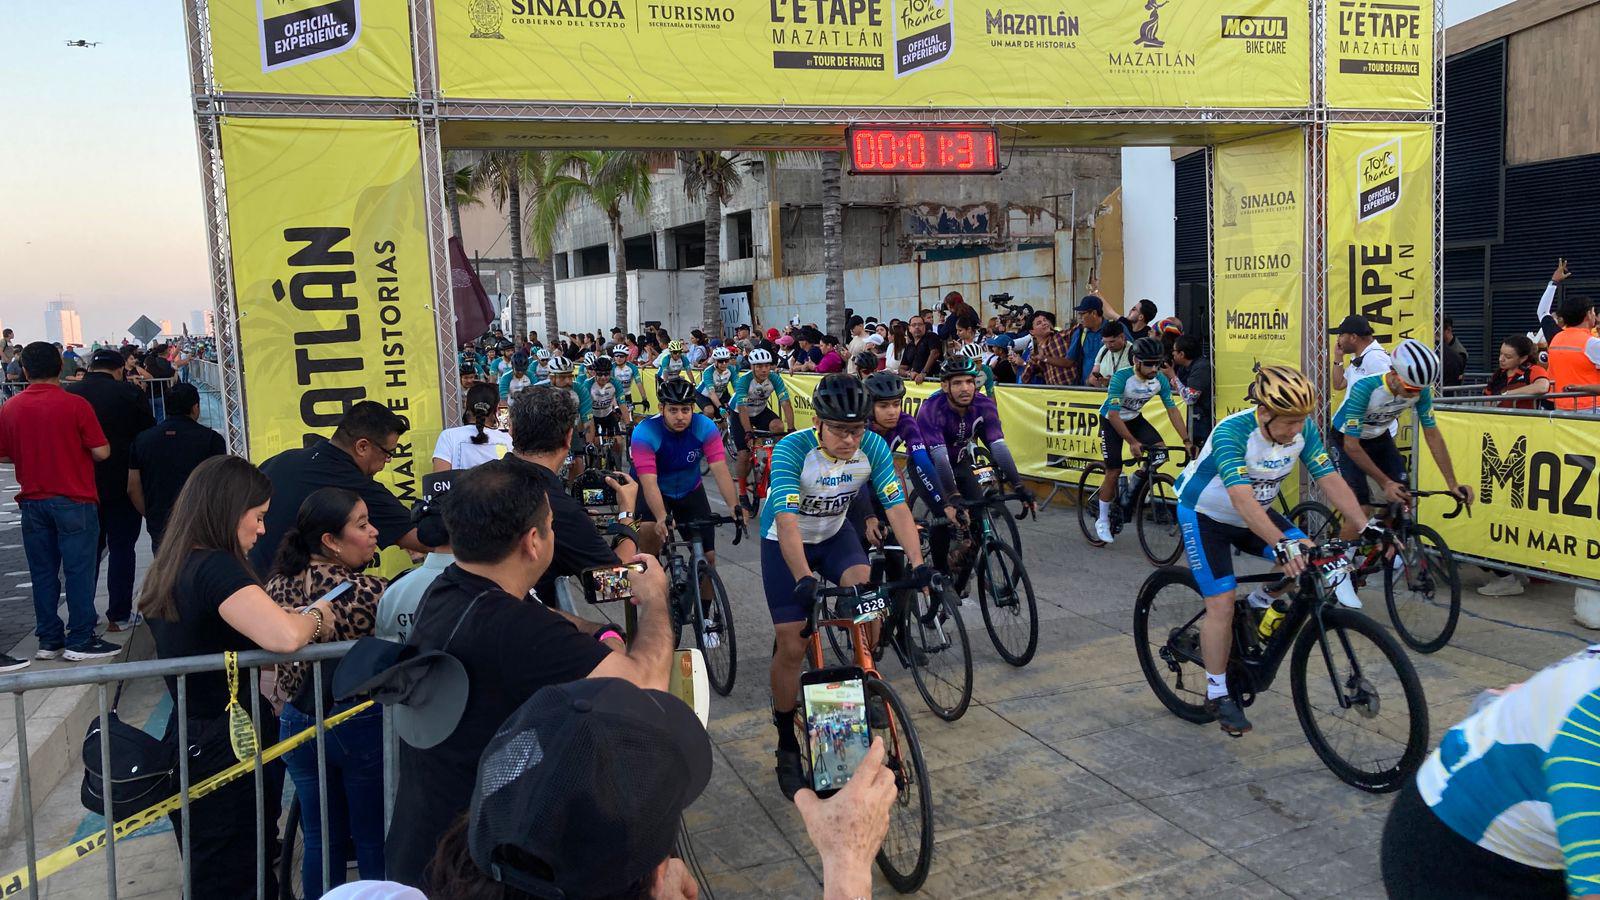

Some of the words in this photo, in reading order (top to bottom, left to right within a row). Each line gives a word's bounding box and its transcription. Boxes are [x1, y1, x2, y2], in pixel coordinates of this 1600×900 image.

[511, 0, 626, 20] SINALOA
[648, 4, 735, 22] TURISMO
[284, 13, 337, 37] OFFICIAL
[511, 18, 563, 26] GOBIERNO
[589, 21, 626, 29] ESTADO
[985, 8, 1080, 37] MAZATLÁN
[1223, 18, 1286, 37] MOTUL
[274, 23, 349, 54] EXPERIENCE
[772, 28, 883, 47] MAZATLÁN
[908, 34, 940, 53] OFFICIAL
[991, 39, 1003, 47] UN
[1005, 40, 1022, 48] MAR
[1036, 41, 1077, 49] HISTORIAS
[902, 41, 947, 65] EXPERIENCE
[1245, 41, 1265, 54] BIKE
[1266, 41, 1287, 54] CARE
[1339, 40, 1419, 57] MAZATLÁN
[813, 55, 837, 67] TOUR
[837, 56, 849, 67] DE
[849, 57, 882, 68] FRANCE
[1109, 50, 1196, 67] MAZATLÁN
[1367, 62, 1385, 72] TOUR
[1385, 63, 1393, 72] DE
[1393, 64, 1418, 73] FRANCE
[855, 131, 995, 169] 00:01:31
[1240, 190, 1296, 210] SINALOA
[1363, 191, 1396, 212] EXPERIENCE
[1368, 186, 1391, 202] OFFICIAL
[1225, 253, 1291, 271] TURISMO
[374, 239, 408, 388] HISTORIAS
[1226, 309, 1289, 330] MAZATLÁN
[272, 227, 367, 449] ATLÁN
[393, 442, 416, 501] MAR
[433, 481, 451, 491] GN
[1490, 522, 1519, 546] UN
[1527, 529, 1577, 556] MAR
[856, 598, 885, 614] 1328
